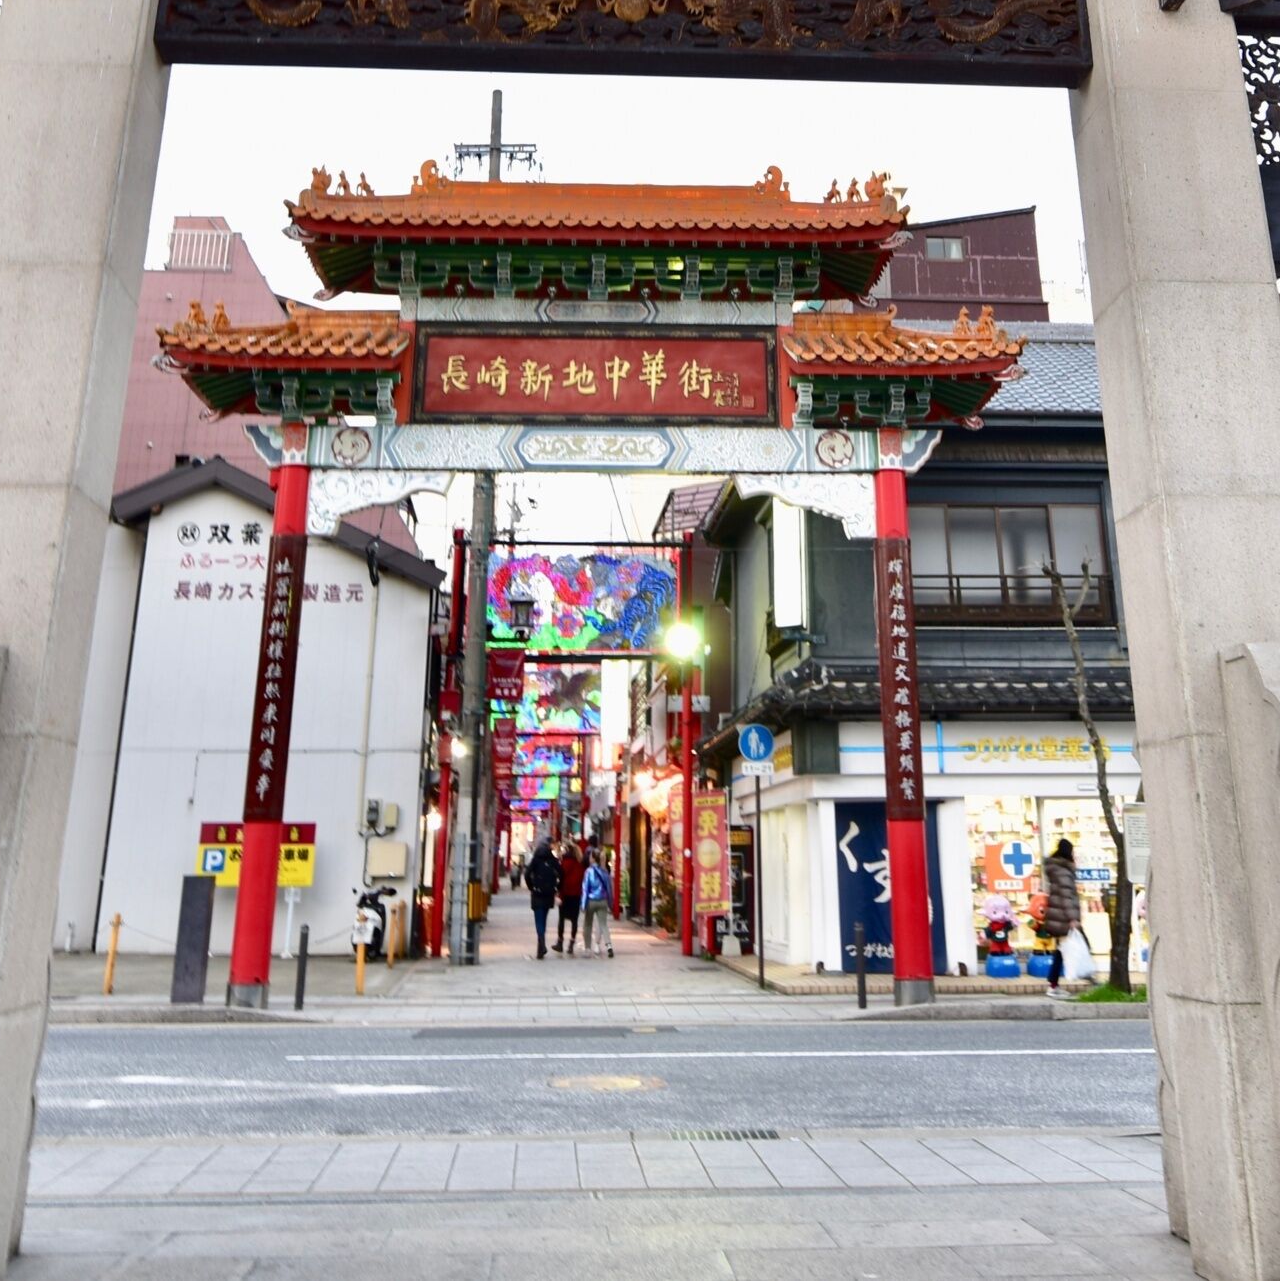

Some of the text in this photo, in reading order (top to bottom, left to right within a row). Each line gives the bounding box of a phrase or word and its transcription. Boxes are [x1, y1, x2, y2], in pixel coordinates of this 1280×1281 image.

[441, 348, 713, 404] 長崎新地中華街
[207, 522, 263, 545] 双葉
